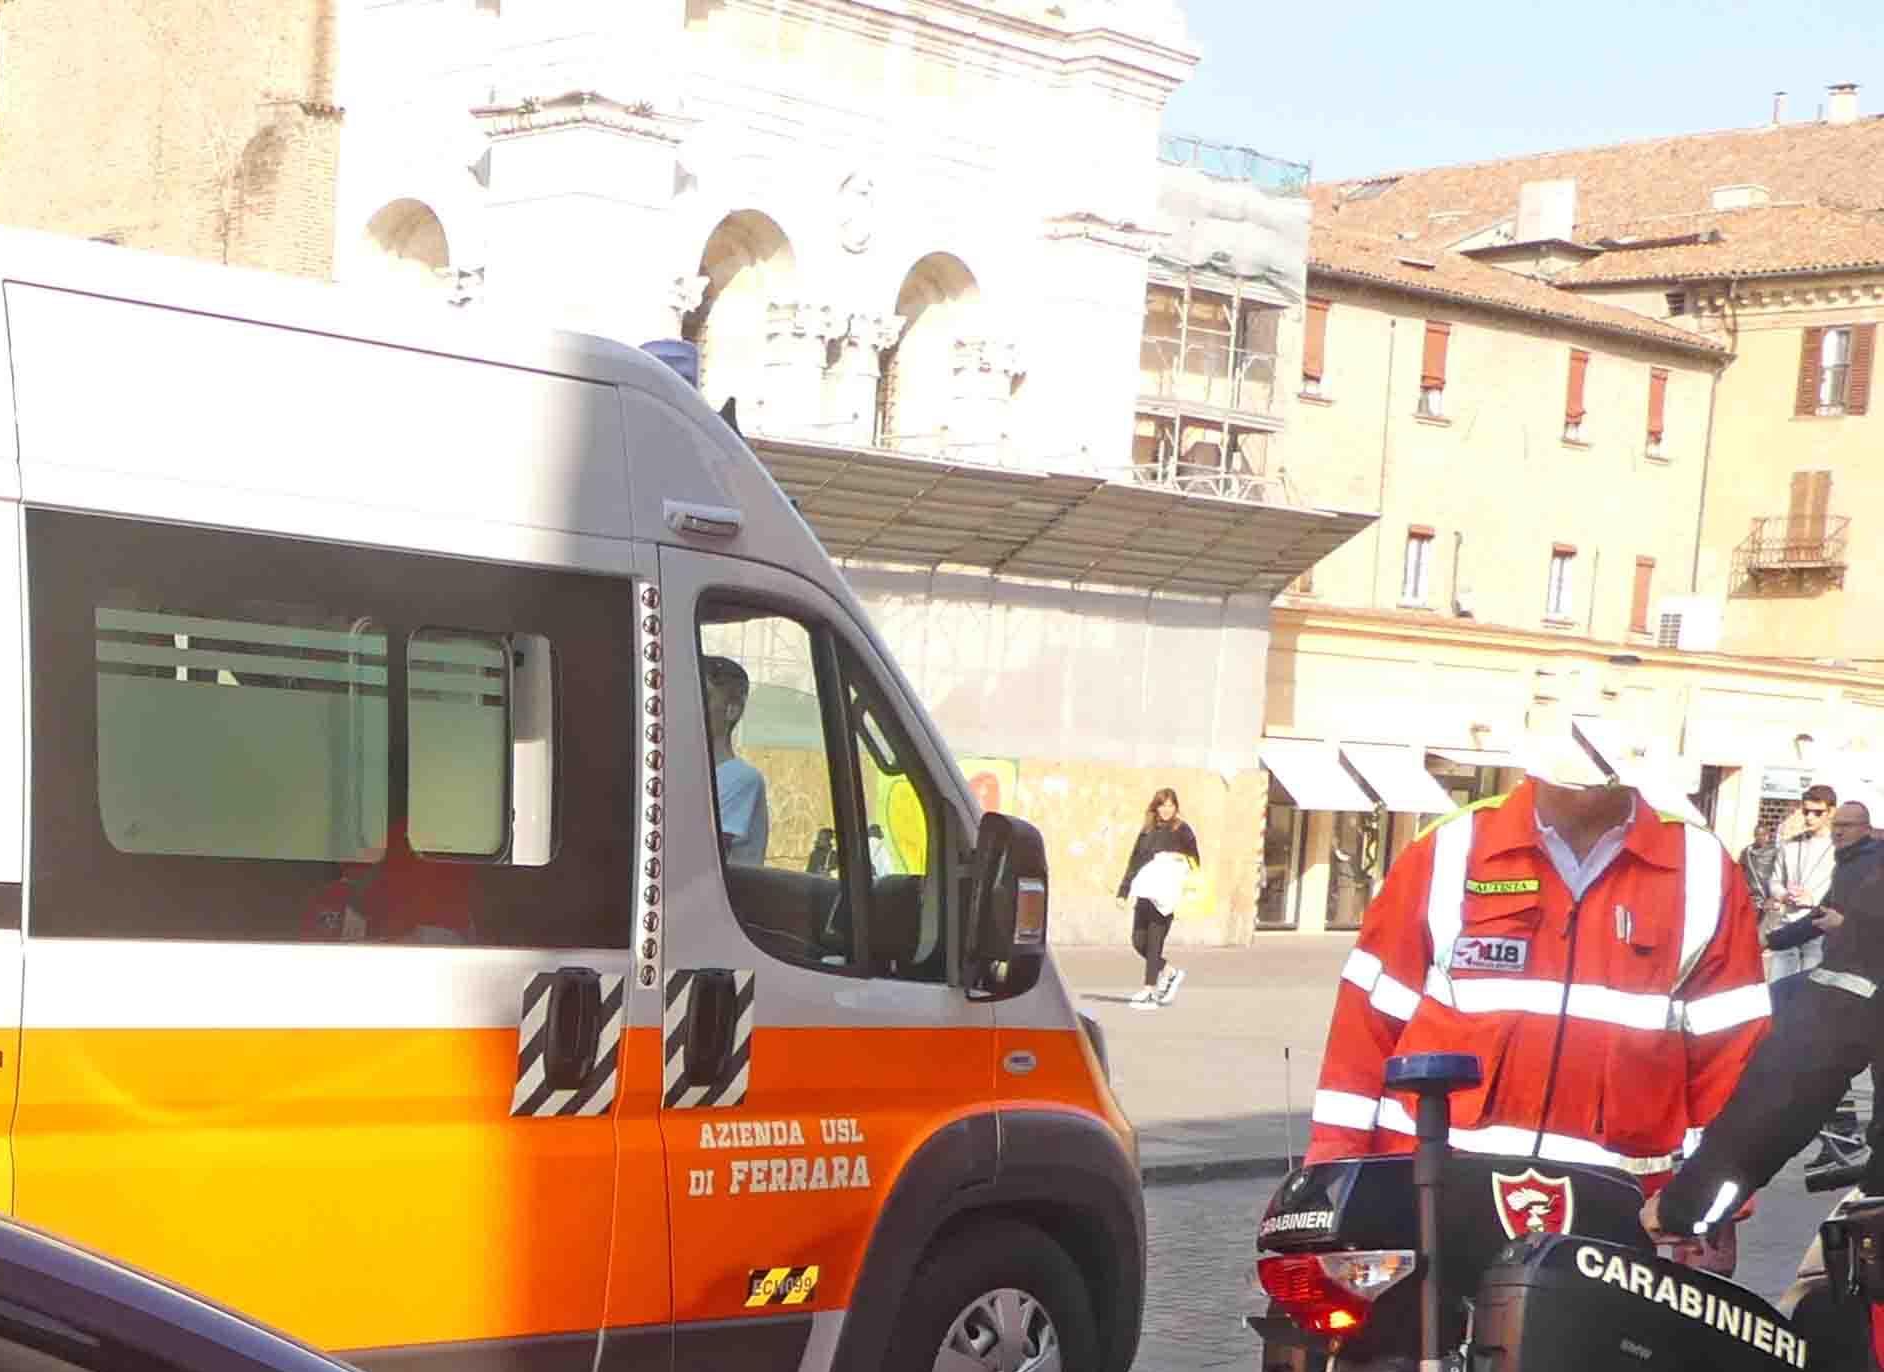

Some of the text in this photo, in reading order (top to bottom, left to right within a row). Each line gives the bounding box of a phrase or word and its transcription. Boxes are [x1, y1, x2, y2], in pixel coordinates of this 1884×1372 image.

[1484, 943, 1519, 963] 118
[699, 1118, 865, 1150] AZIENDA USL
[688, 1155, 872, 1197] DI FERRARA
[1260, 1210, 1335, 1236] CARABINIERI
[1575, 1245, 1808, 1370] CARABINIERI
